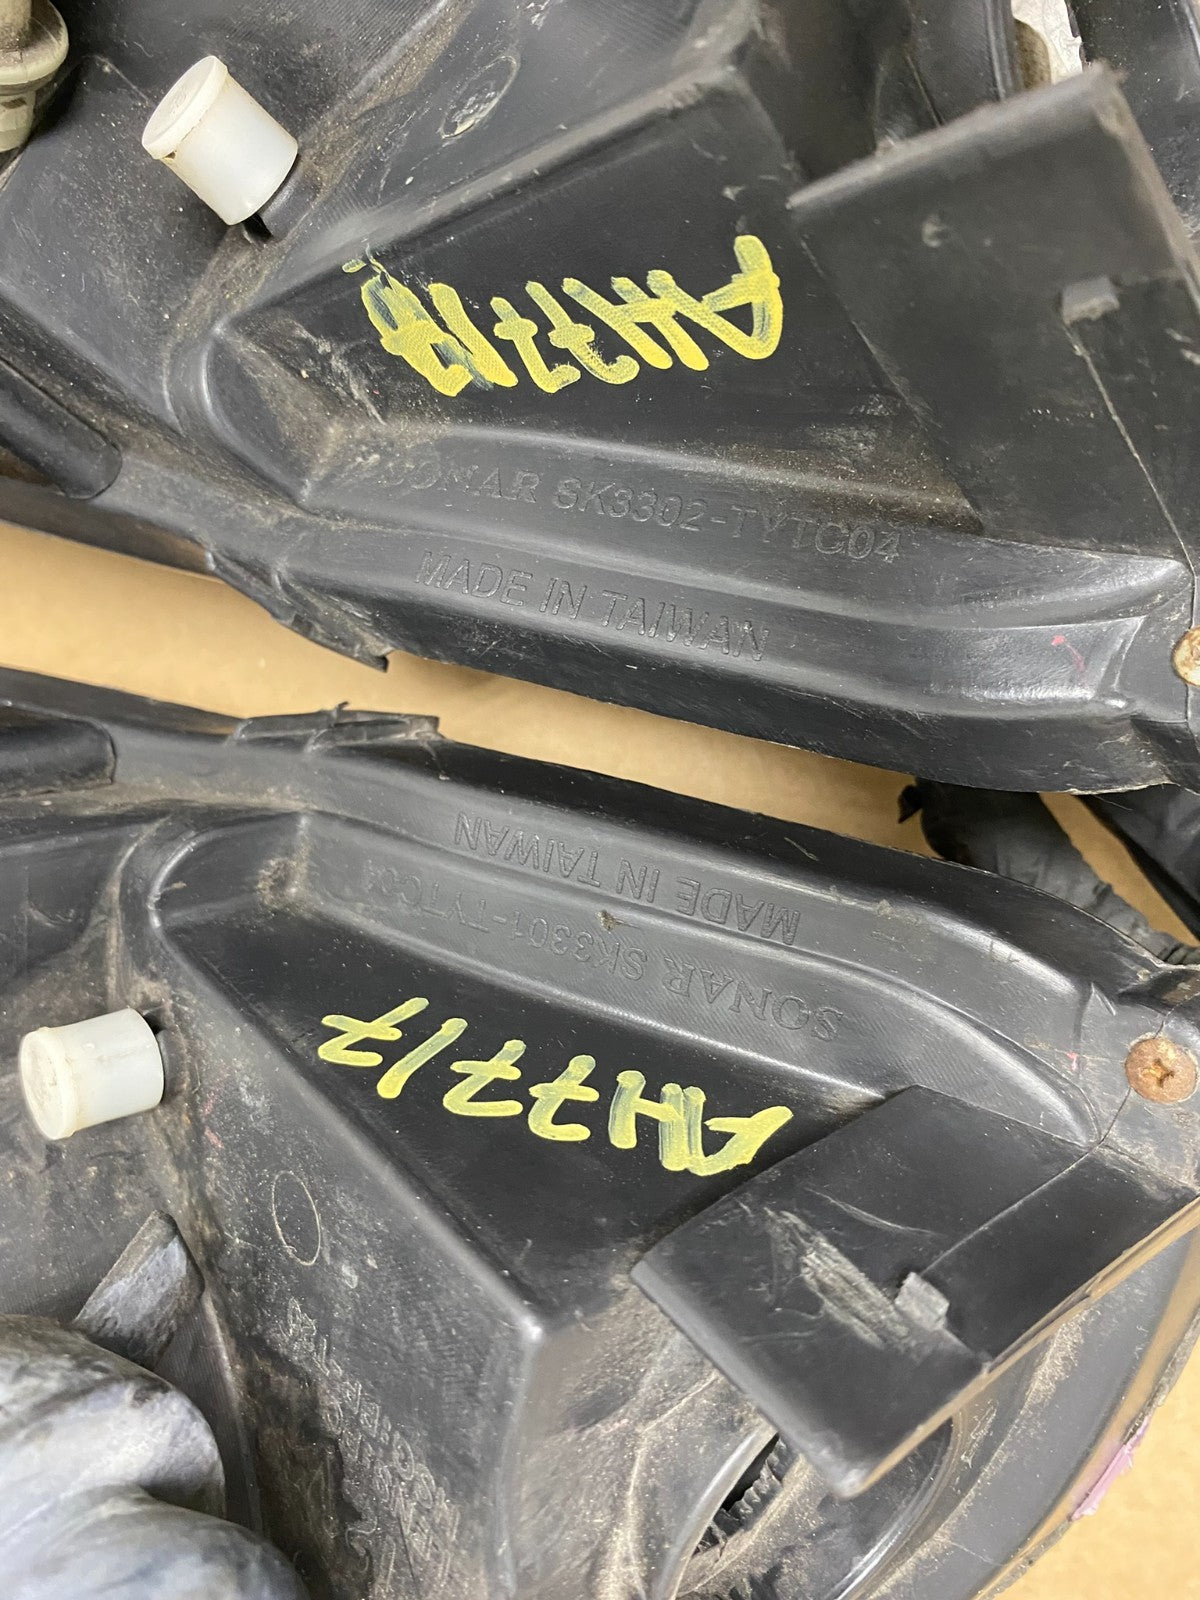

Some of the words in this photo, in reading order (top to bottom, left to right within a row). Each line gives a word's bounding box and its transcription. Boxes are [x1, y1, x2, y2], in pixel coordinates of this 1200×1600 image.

[415, 550, 534, 607] MADE
[540, 576, 589, 620] IN
[600, 588, 769, 662] TAIWAN
[451, 811, 601, 888] TAIWAN
[614, 859, 661, 904] IN
[675, 877, 801, 946] MADE
[661, 956, 843, 1043] SONAR
